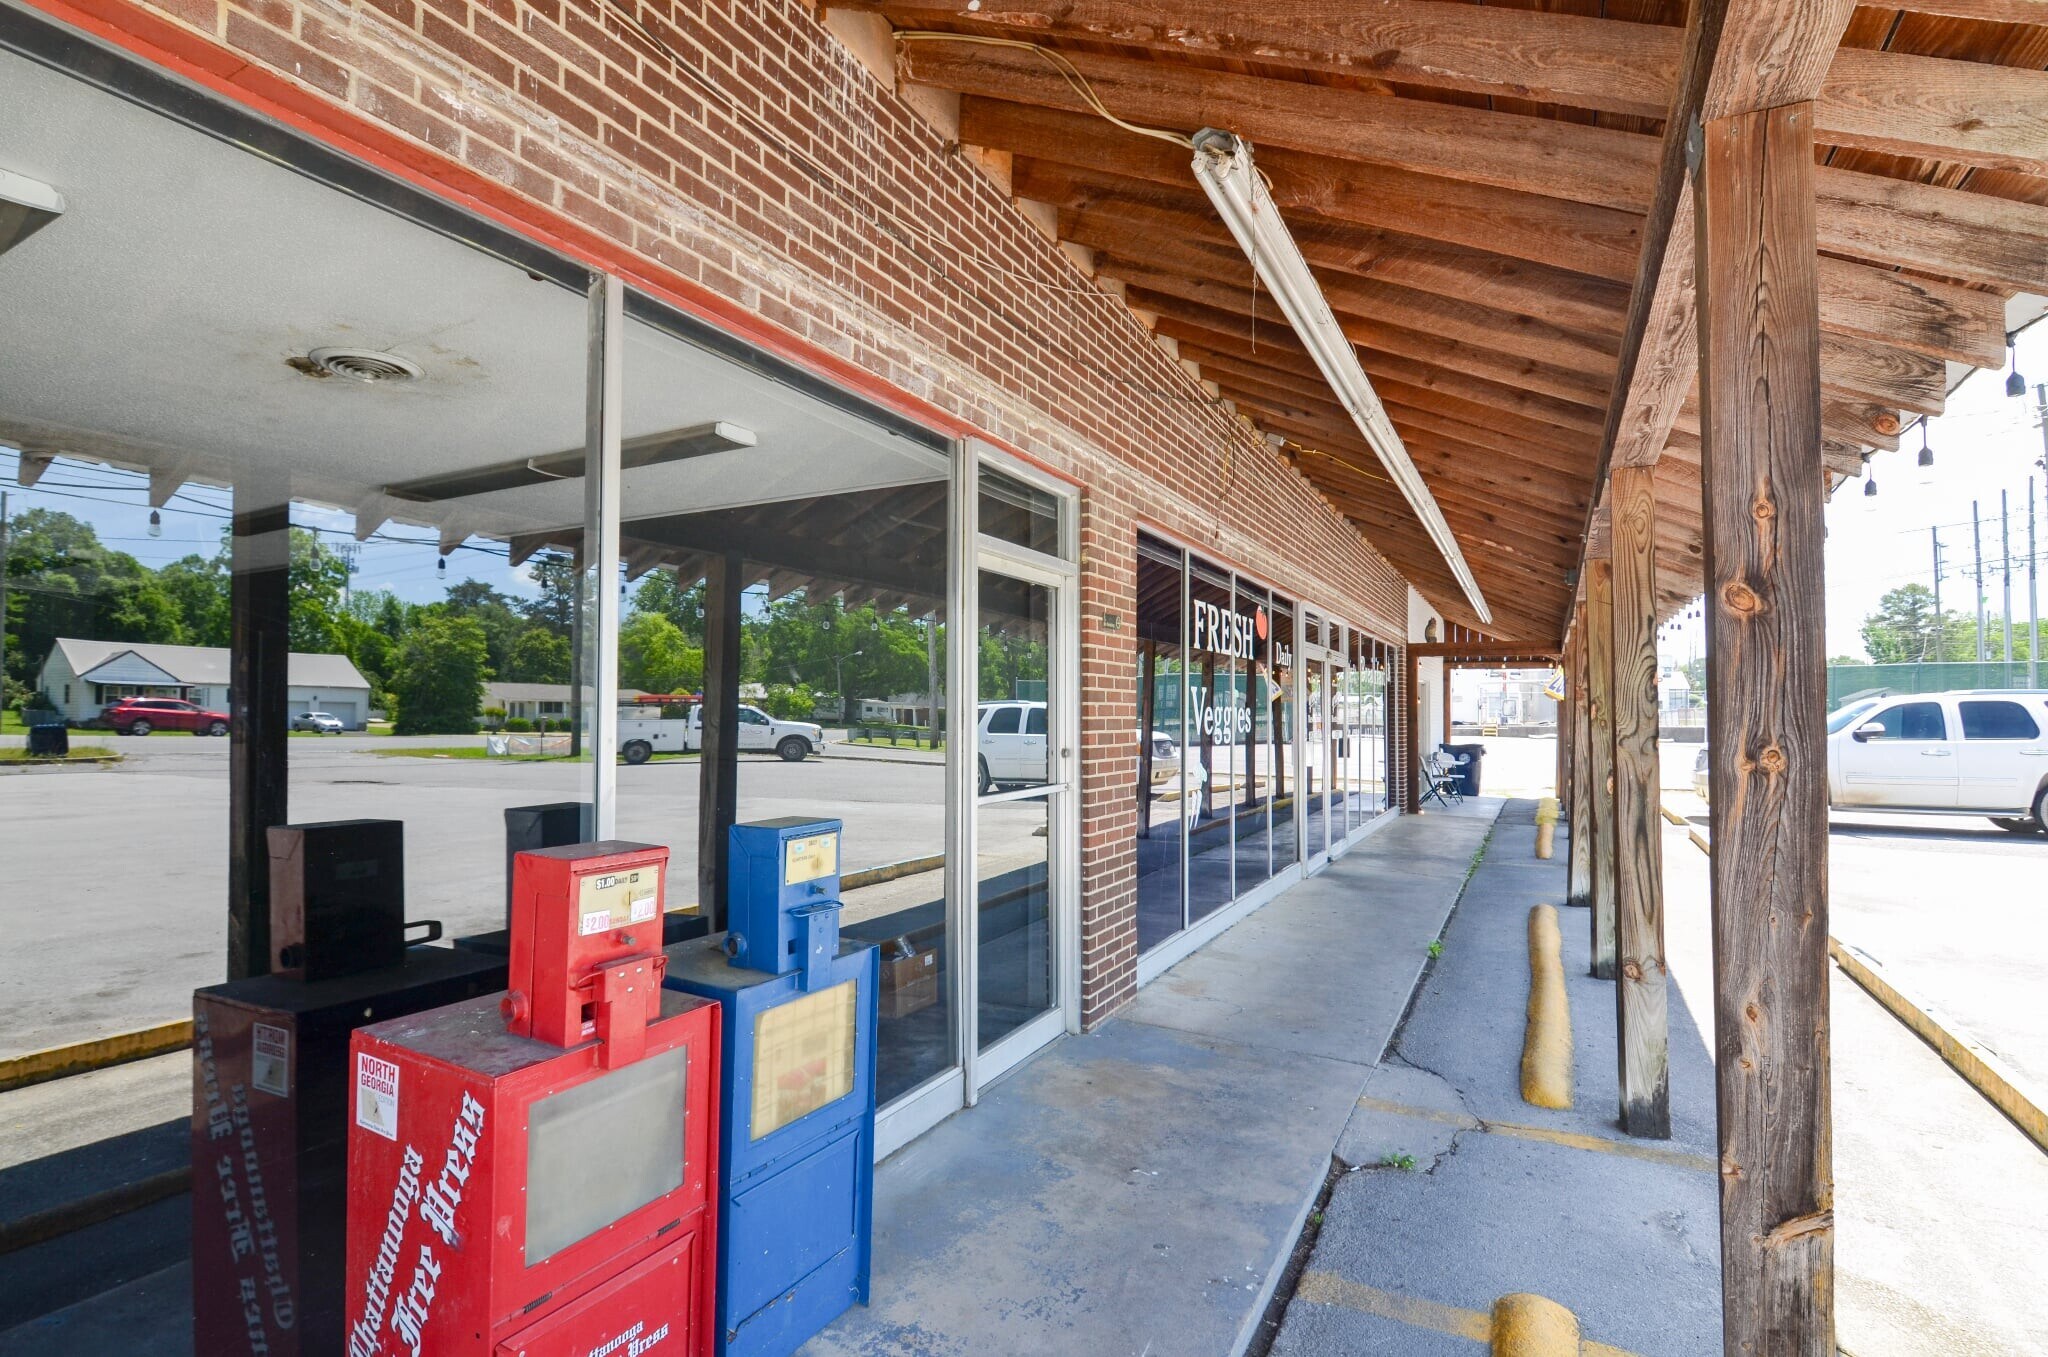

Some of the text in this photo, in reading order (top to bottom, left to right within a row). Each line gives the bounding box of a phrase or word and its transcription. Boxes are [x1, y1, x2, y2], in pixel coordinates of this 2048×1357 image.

[1193, 599, 1254, 660] FRESH
[1276, 641, 1292, 671] Daily
[1190, 685, 1252, 745] Veggies
[596, 876, 615, 889] $1.00
[585, 914, 610, 931] $2.00
[361, 1055, 396, 1083] NORTH
[361, 1073, 394, 1097] GEORGIA
[391, 1089, 485, 1357] Free Press
[586, 1320, 644, 1357] ttanooga
[627, 1323, 669, 1357] Press
